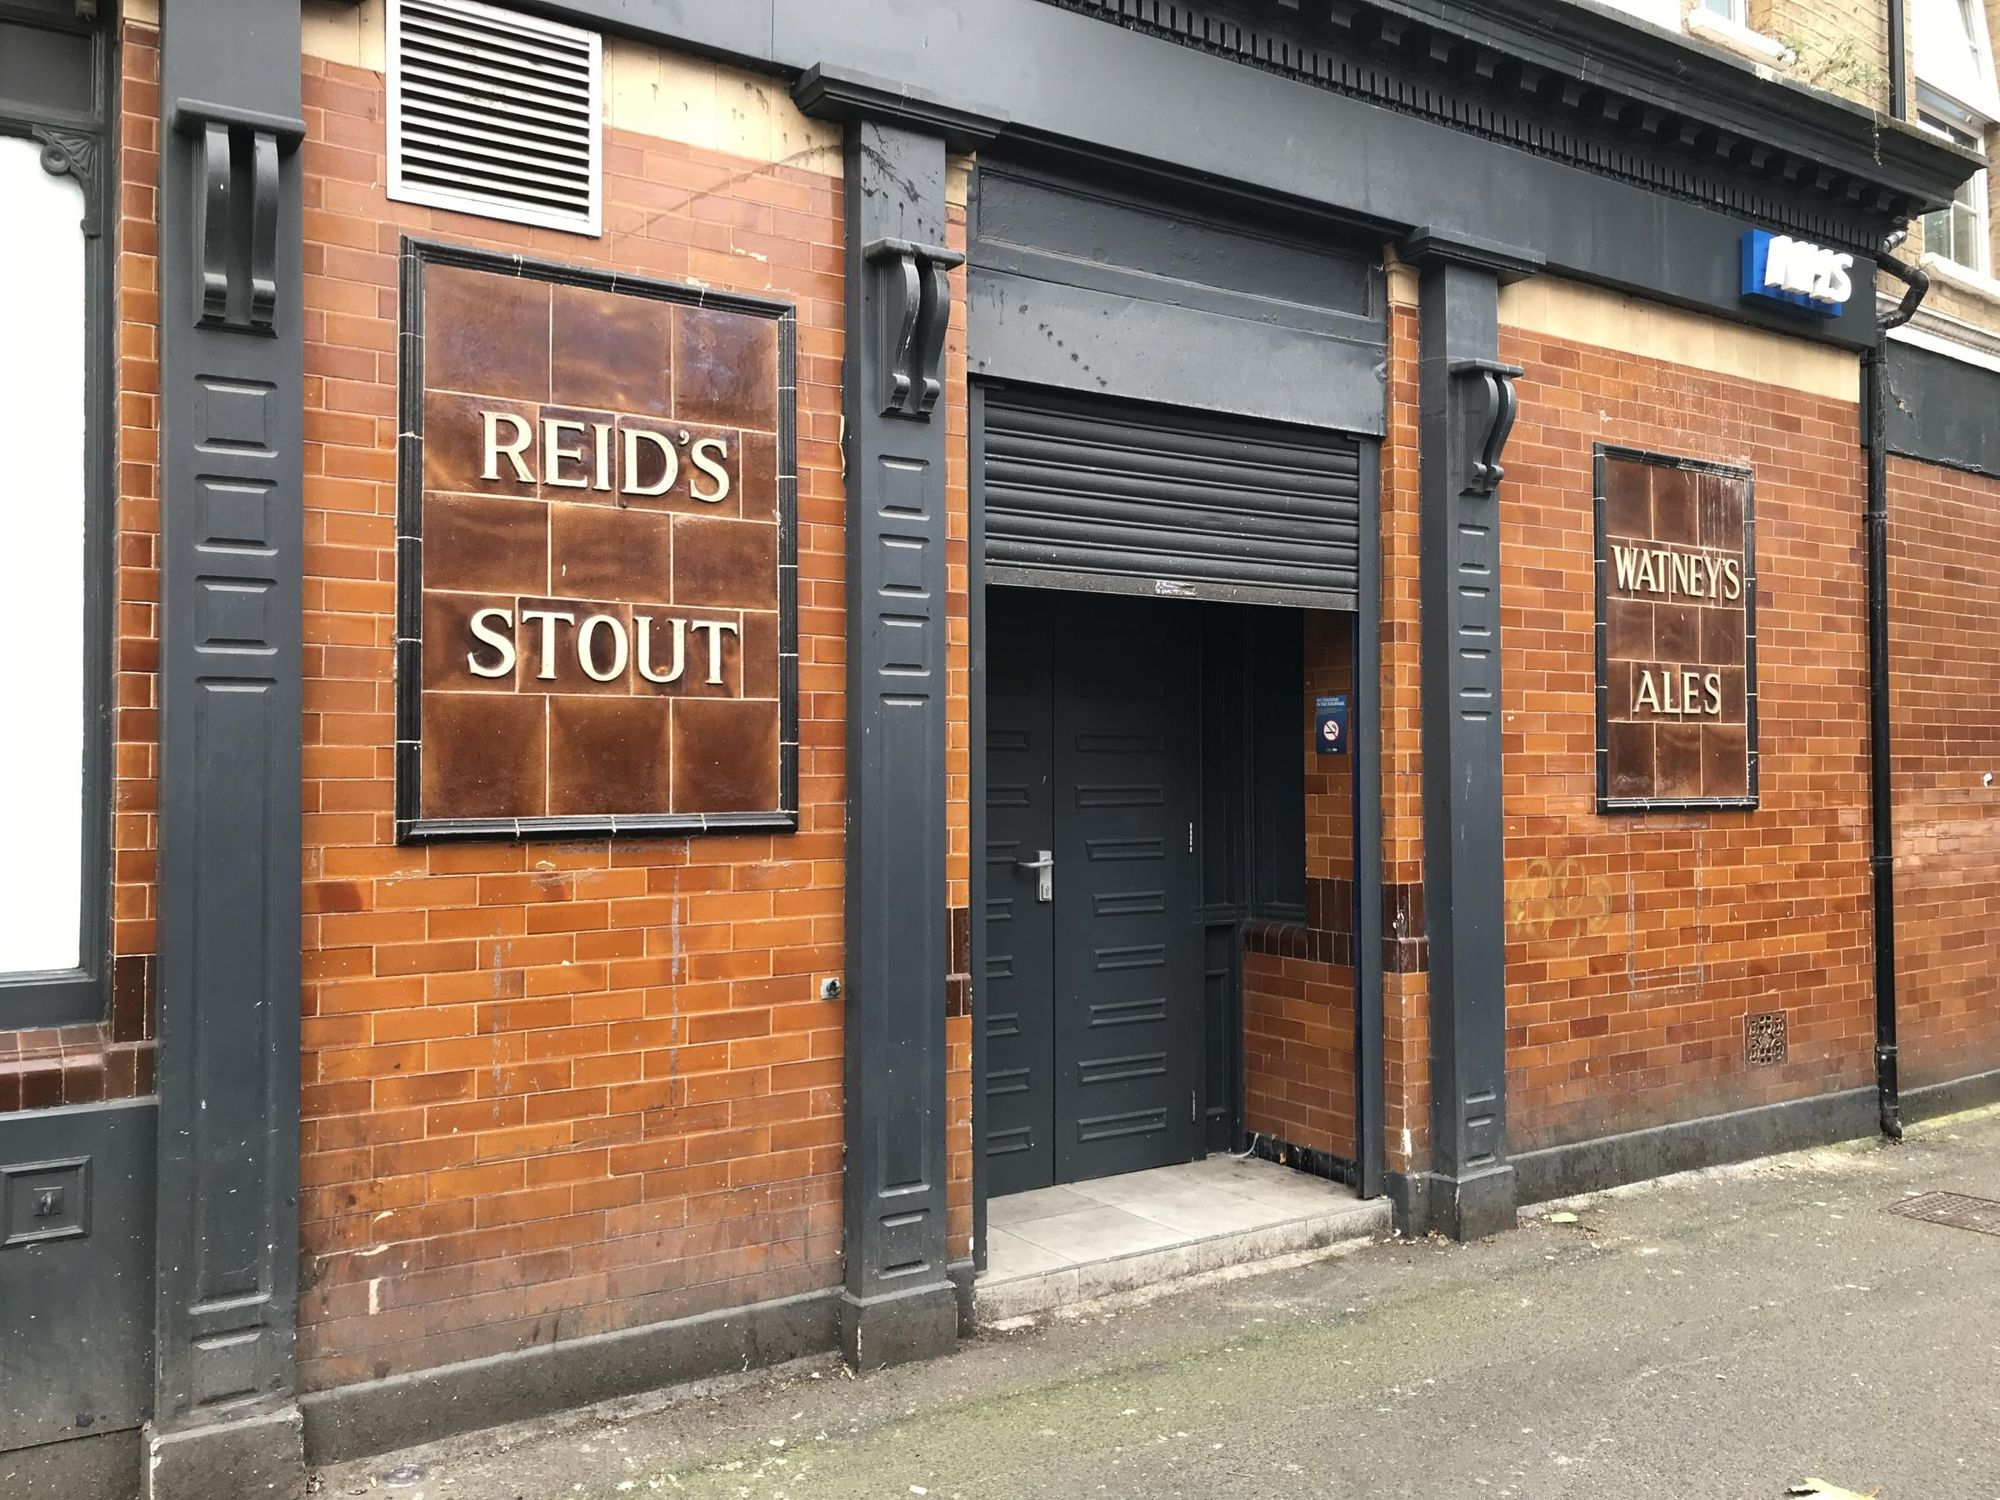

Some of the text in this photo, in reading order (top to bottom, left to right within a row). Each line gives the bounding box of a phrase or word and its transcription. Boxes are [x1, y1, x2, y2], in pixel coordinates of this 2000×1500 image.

[479, 409, 731, 504] REID'S
[1611, 544, 1741, 601] WATNEY'S
[466, 607, 739, 685] STOUT
[1633, 669, 1722, 716] ALES
